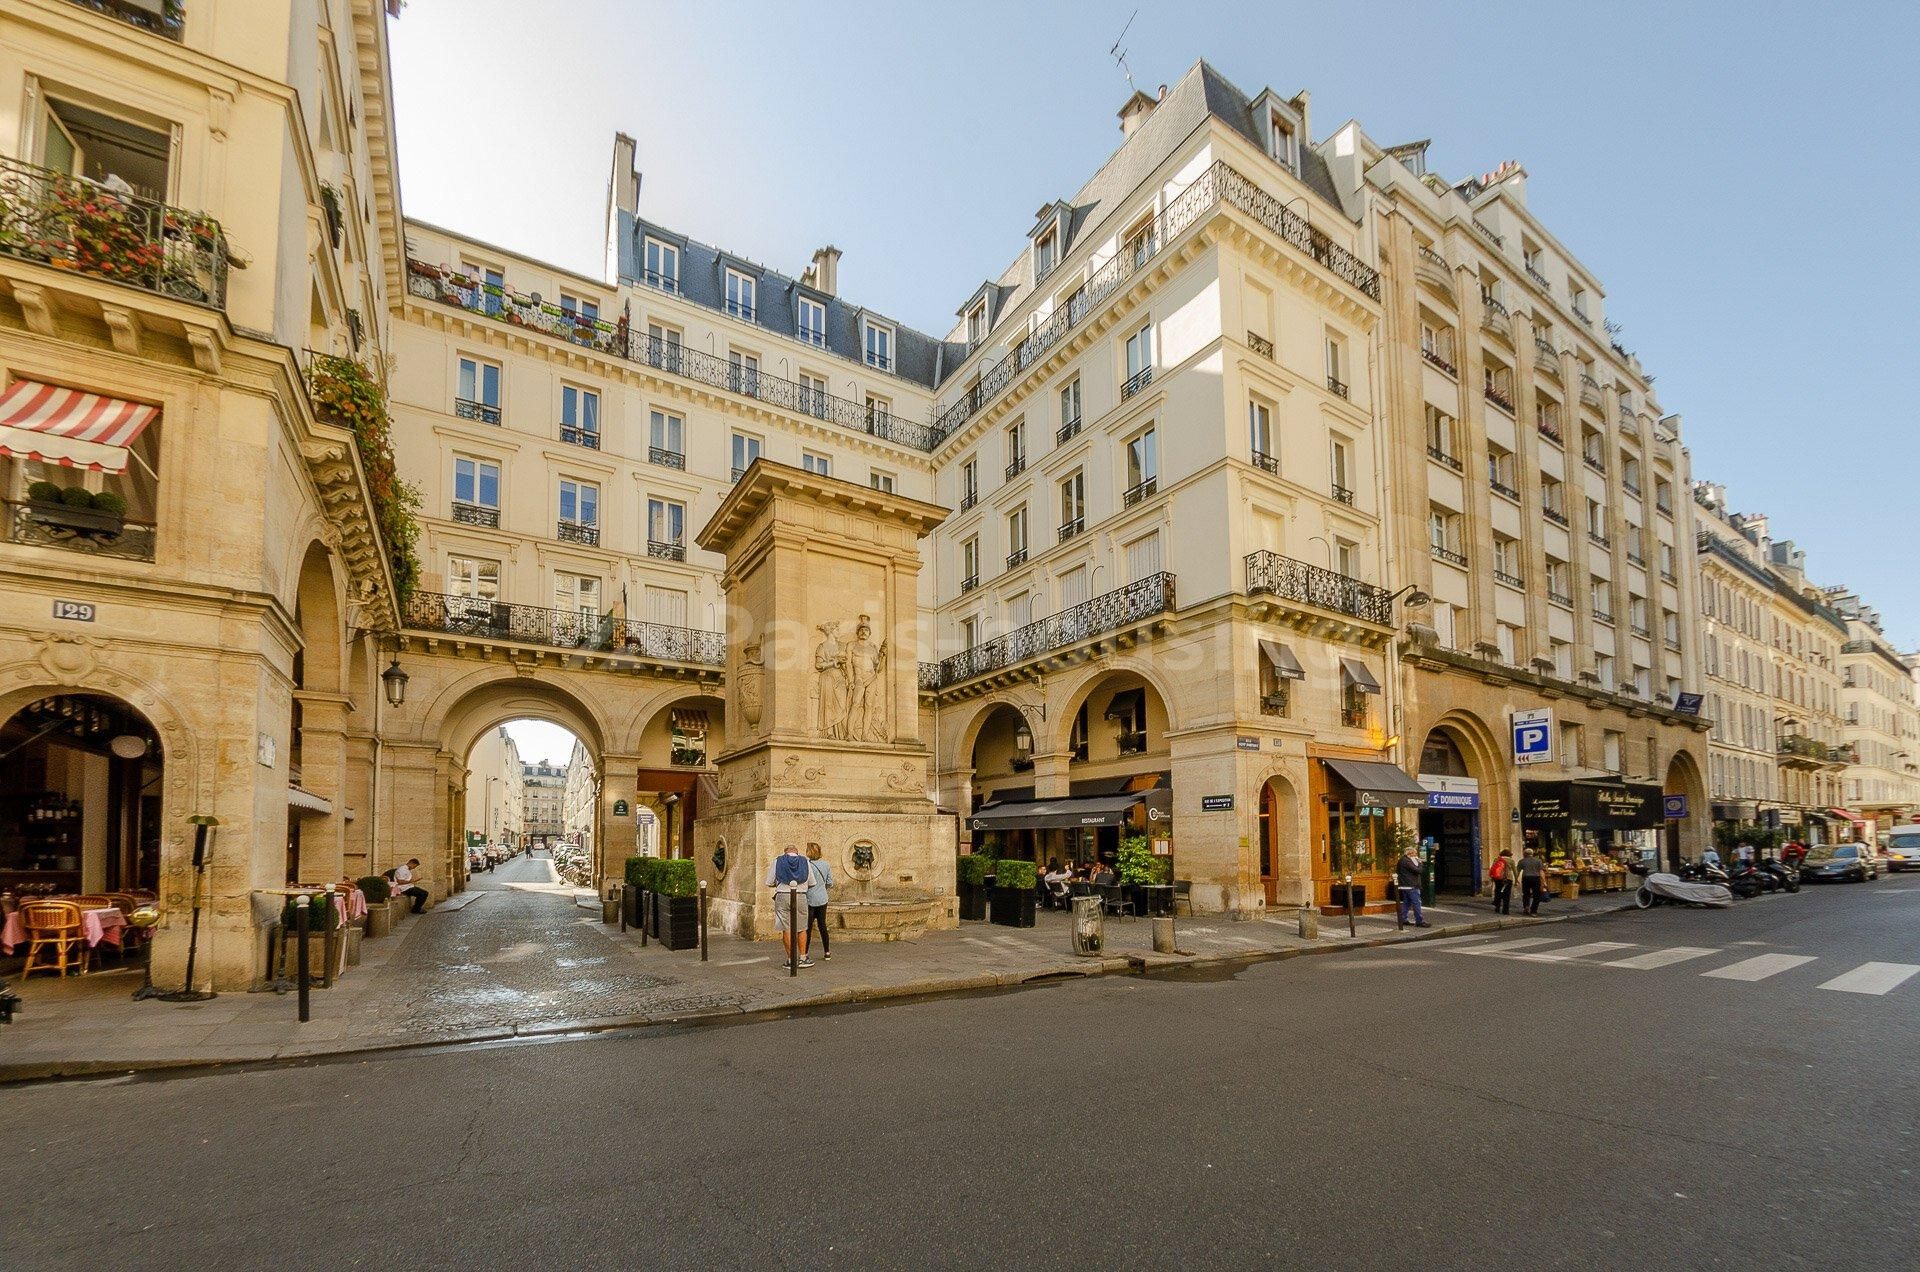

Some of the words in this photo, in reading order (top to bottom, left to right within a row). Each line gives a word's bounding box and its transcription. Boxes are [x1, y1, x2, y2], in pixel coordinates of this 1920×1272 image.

[56, 602, 92, 620] 129
[1523, 730, 1543, 750] P
[1440, 795, 1472, 806] DOMINIQUE
